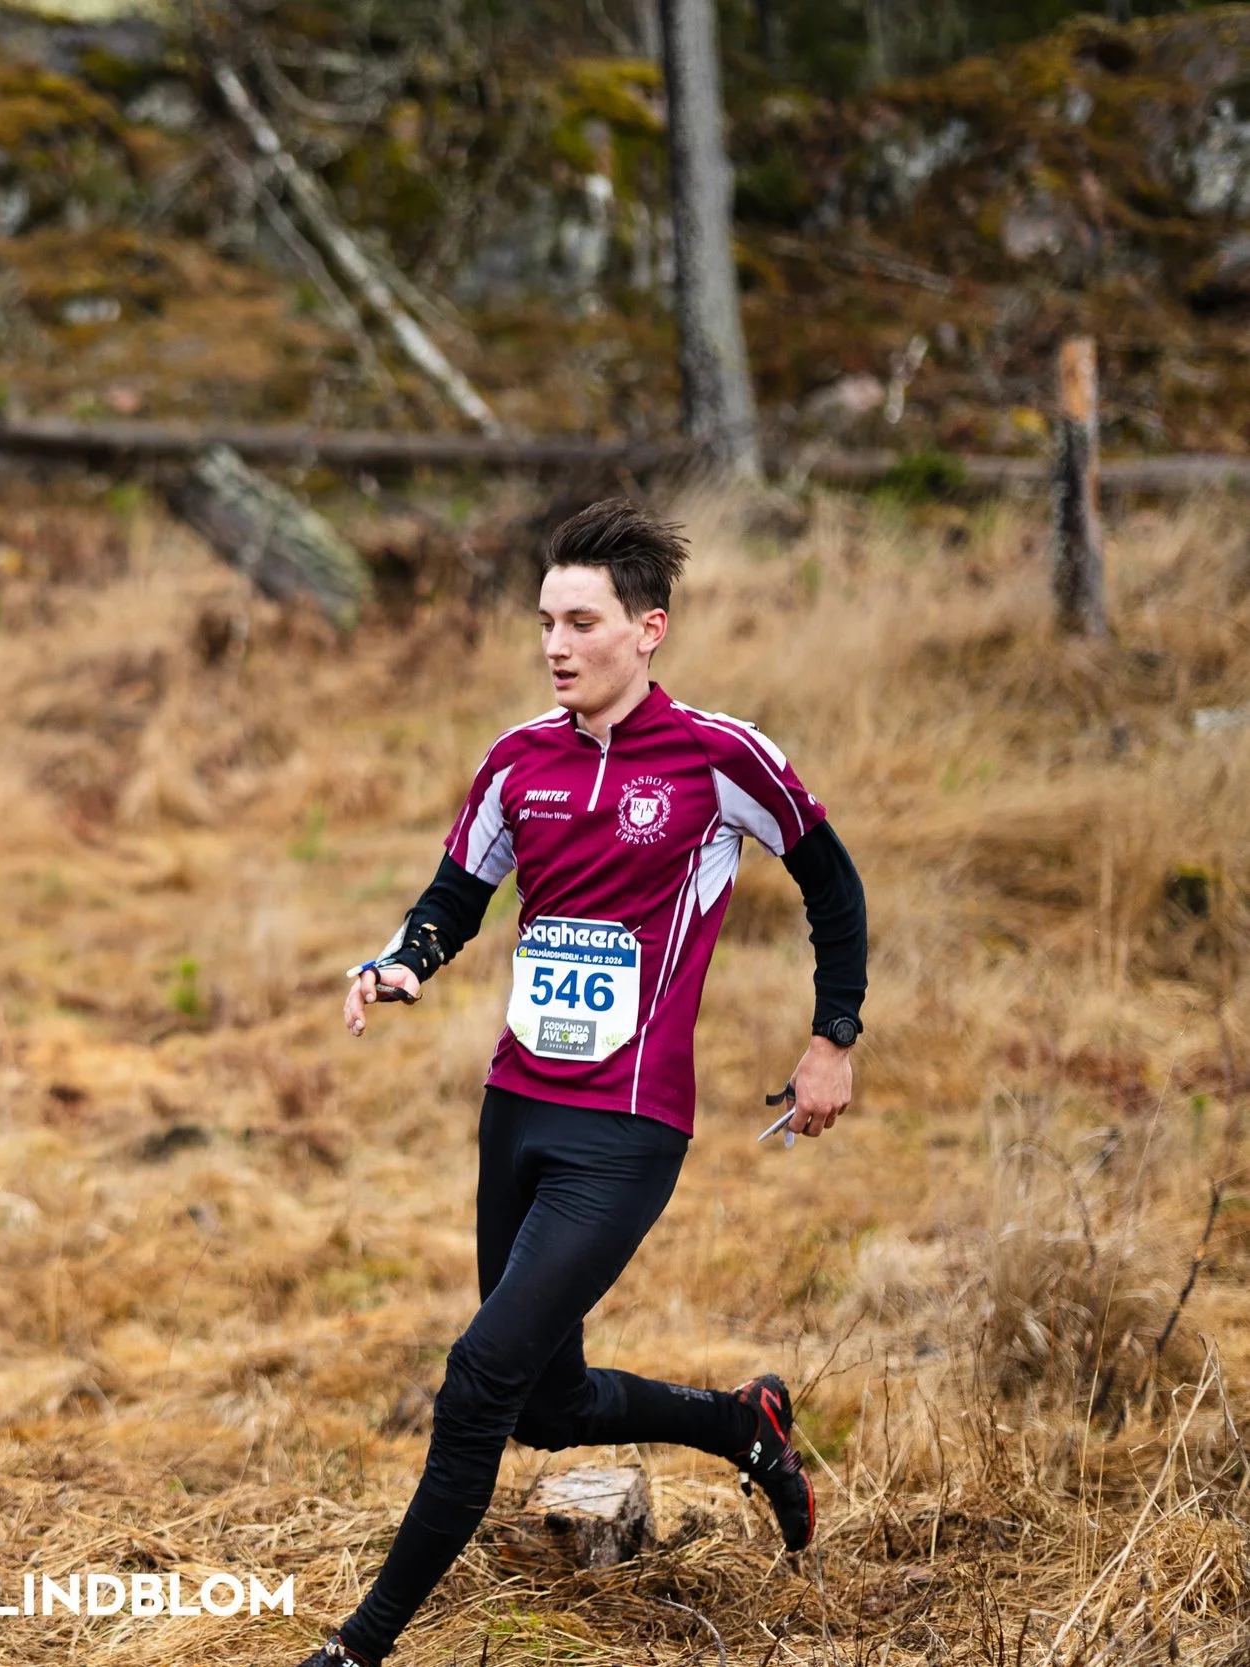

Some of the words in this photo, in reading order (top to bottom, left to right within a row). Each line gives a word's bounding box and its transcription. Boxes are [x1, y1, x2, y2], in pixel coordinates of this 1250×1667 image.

[621, 775, 662, 792] RASBO
[662, 782, 676, 796] IK
[524, 790, 571, 802] TRIMTEX
[615, 828, 667, 845] UPPSALA
[604, 957, 623, 965] 2026
[530, 966, 615, 1012] 546
